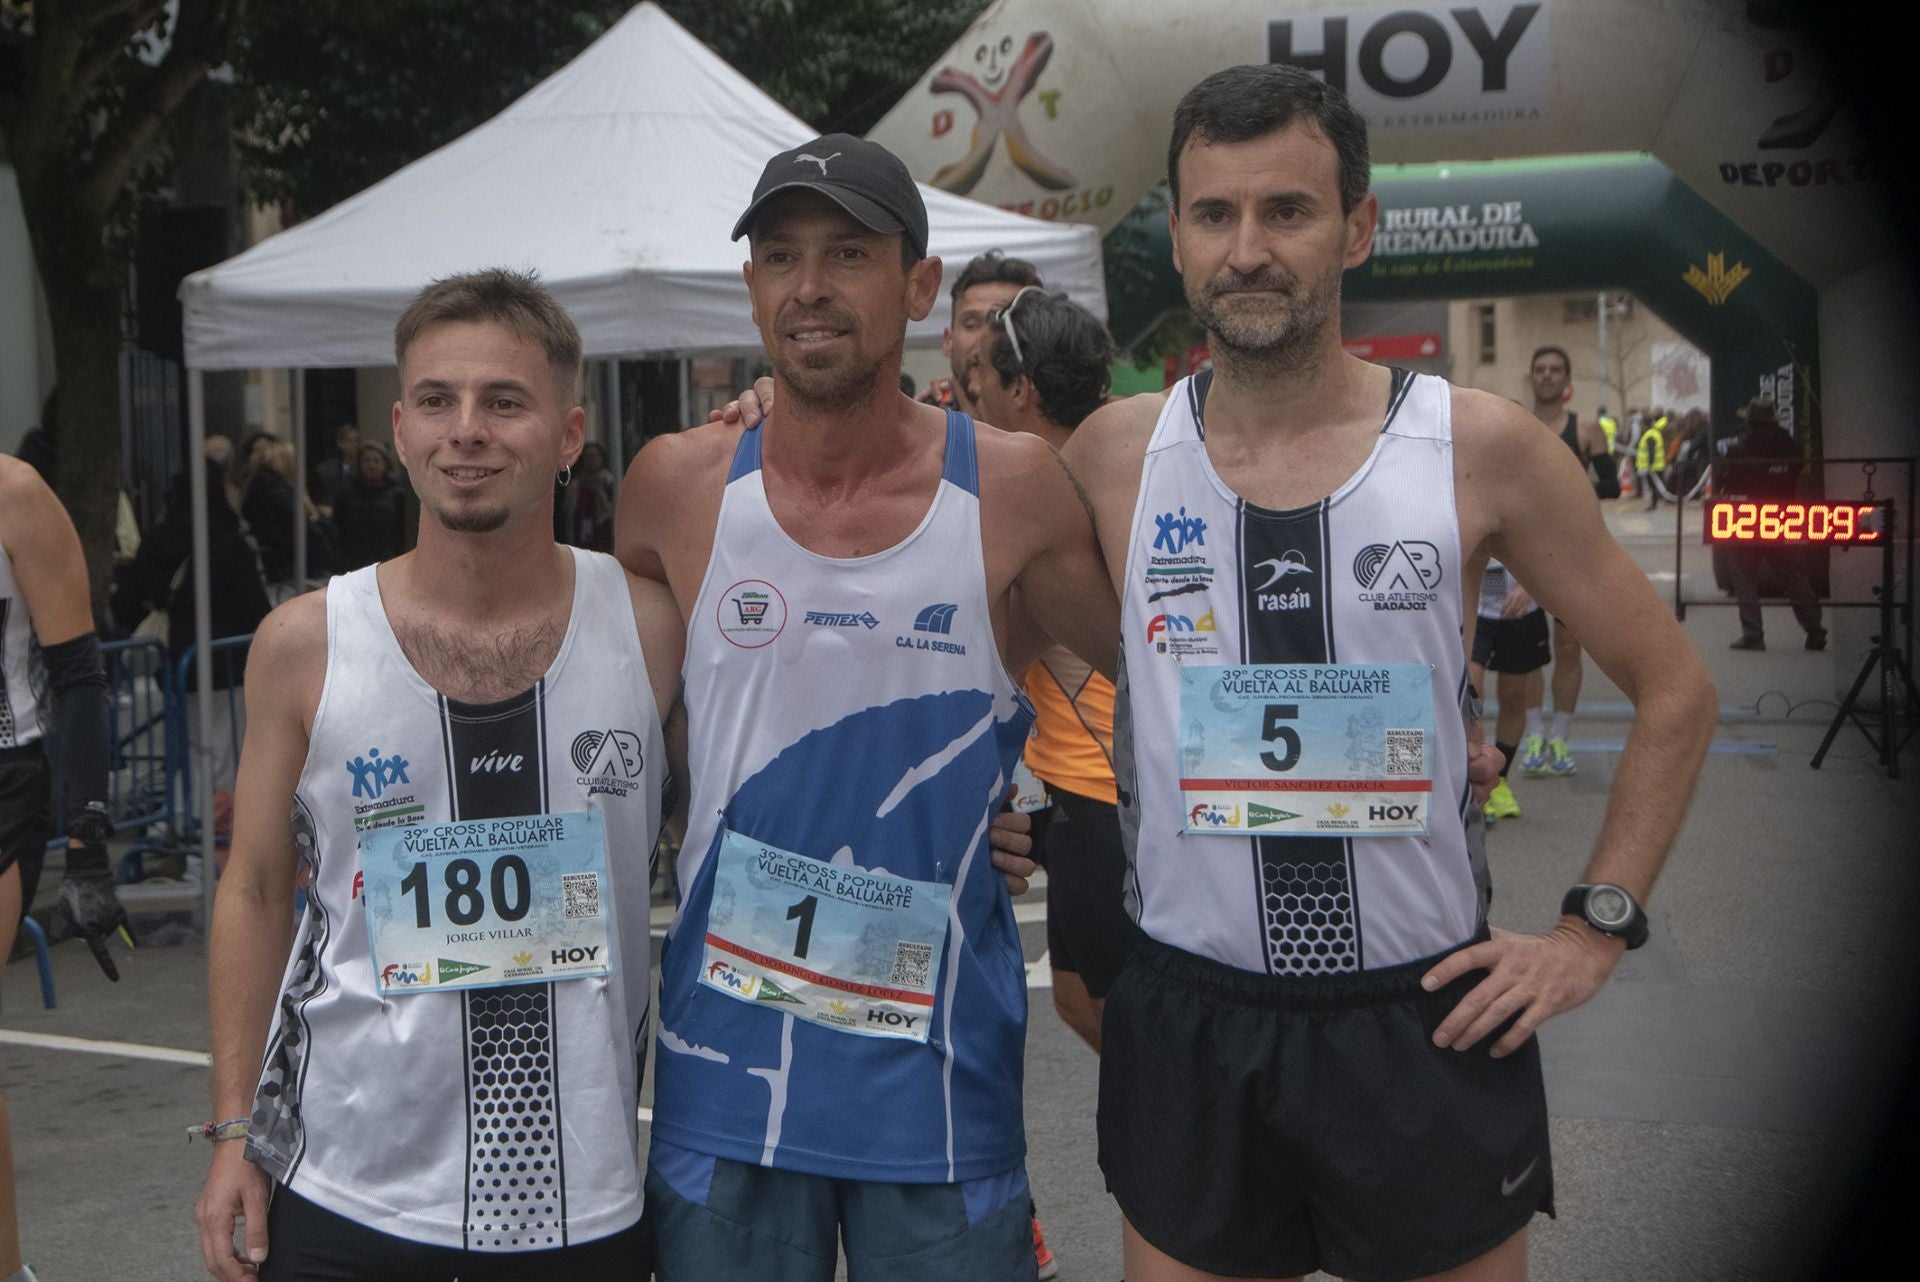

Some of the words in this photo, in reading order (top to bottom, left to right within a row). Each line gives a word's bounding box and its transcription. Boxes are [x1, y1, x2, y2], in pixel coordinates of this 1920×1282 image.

[1268, 3, 1541, 98] HOY
[1385, 204, 1477, 231] RURAL
[1482, 200, 1522, 224] DE
[1373, 223, 1539, 256] REMADURA
[1151, 555, 1206, 565] Extremadura
[1171, 575, 1190, 583] desde
[1258, 587, 1310, 611] rasán
[1358, 593, 1385, 601] CLUB
[1387, 592, 1438, 601] ATLETISMO
[744, 605, 762, 613] ARG
[1374, 602, 1427, 611] BADAJOZ
[804, 611, 862, 627] PENTEX
[896, 636, 914, 648] C.A.
[917, 639, 930, 650] LA
[931, 641, 966, 656] SERENA
[1253, 669, 1308, 680] CROSS
[1314, 669, 1390, 680] POPULAR
[1222, 680, 1279, 694] VUELTA
[1284, 680, 1305, 694] AL
[1309, 680, 1391, 694] BALUARTE
[1259, 704, 1302, 772] 5
[576, 777, 600, 785] CLUB
[600, 777, 639, 790] ATLETISMO
[354, 795, 415, 814] Extremadura
[1369, 805, 1418, 820] HOY
[373, 820, 395, 830] desde
[397, 816, 405, 825] la
[407, 814, 424, 823] Base
[433, 823, 486, 837] CROSS
[492, 817, 564, 833] POPULAR
[404, 835, 461, 853] VUELTA
[464, 834, 485, 848] AL
[489, 828, 565, 846] BALUARTE
[563, 873, 597, 881] RESULTADO
[758, 858, 809, 885] VUELTA
[813, 878, 830, 892] AL
[836, 883, 912, 908] BALUARTE
[787, 855, 838, 880] CROSS
[843, 873, 913, 895] POPULAR
[400, 854, 531, 928] 180
[786, 895, 819, 960] 1
[445, 931, 486, 946] JORGE
[488, 928, 533, 941] VILLAR
[551, 946, 599, 964] HOY
[732, 944, 757, 961] JUAN
[760, 956, 818, 980] DOMINGO
[867, 1010, 919, 1028] HOY
